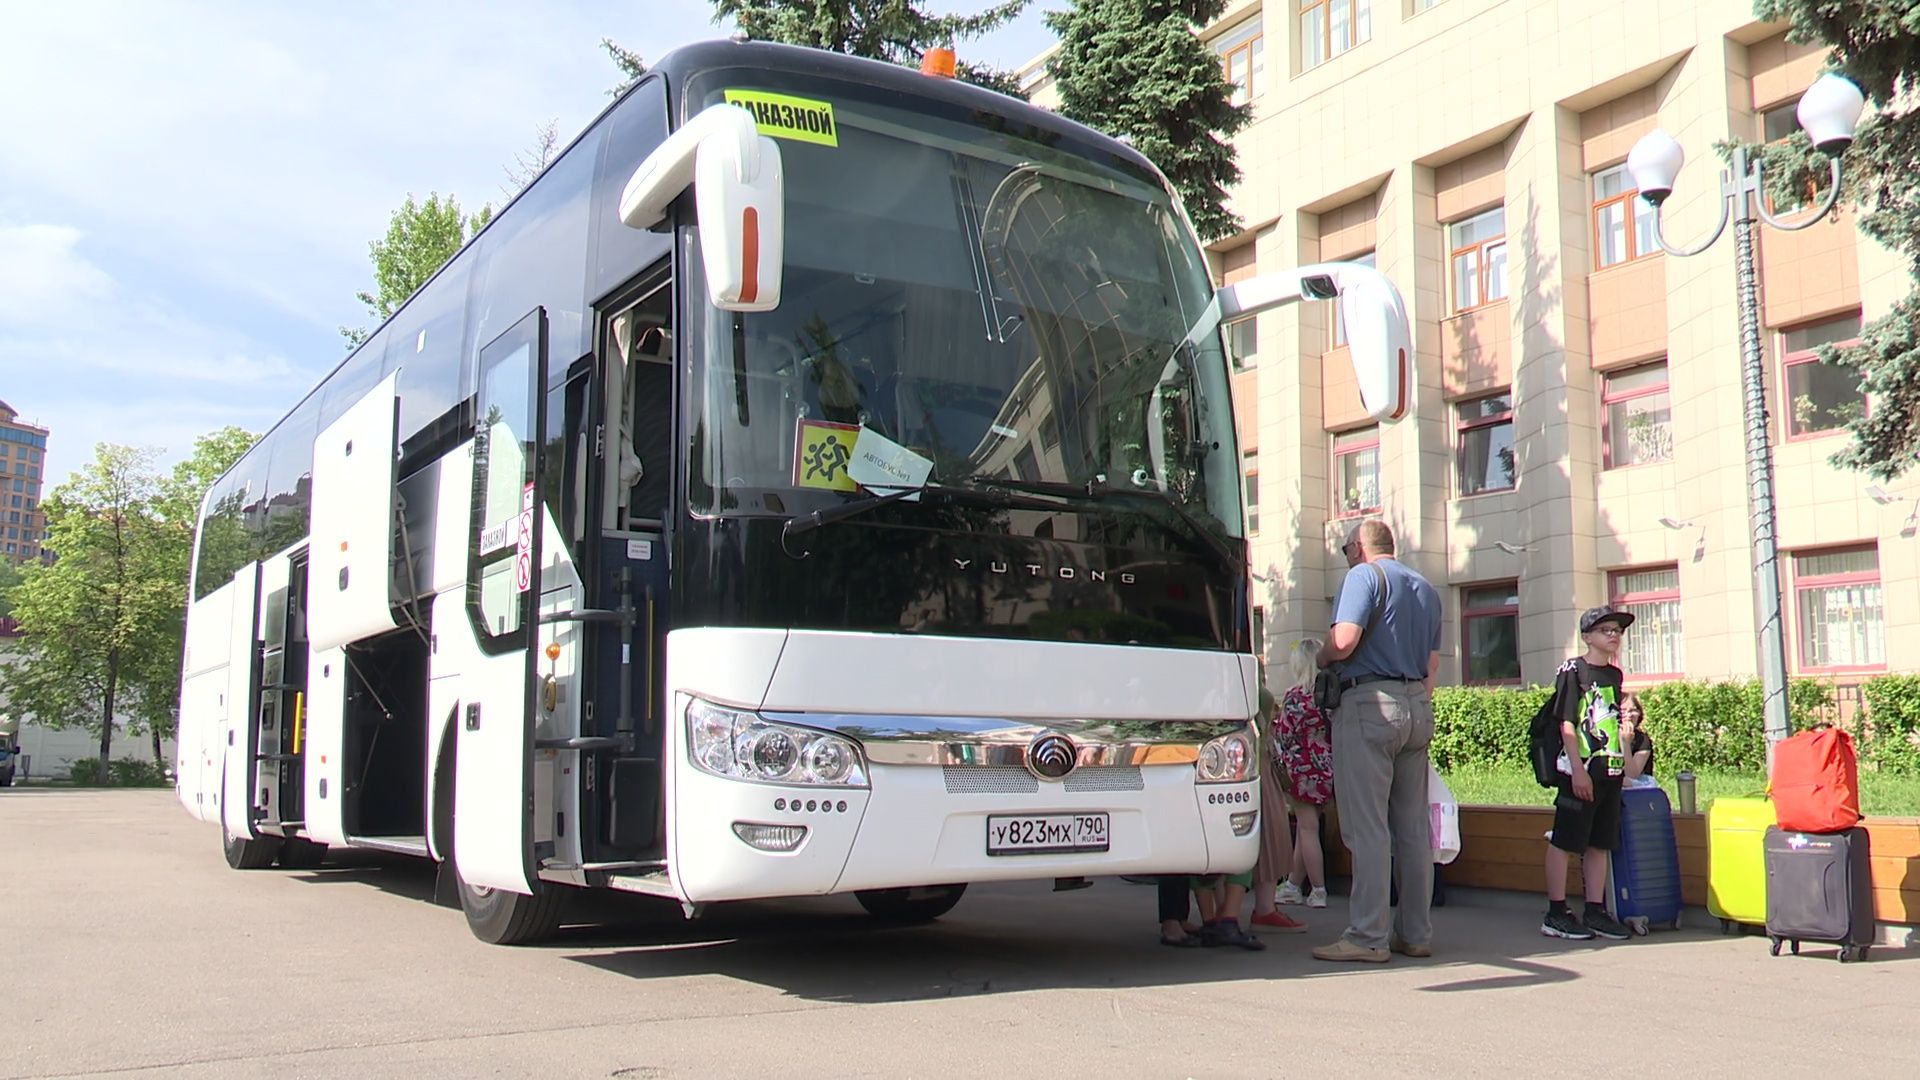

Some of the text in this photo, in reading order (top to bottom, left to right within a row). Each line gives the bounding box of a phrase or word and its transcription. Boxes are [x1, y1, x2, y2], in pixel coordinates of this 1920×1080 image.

[731, 100, 833, 136] АКАЗНОЙ
[863, 451, 896, 475] АВТОБУС
[954, 558, 1135, 584] YUTONG
[1076, 817, 1103, 836] 790
[1081, 835, 1096, 843] RUS
